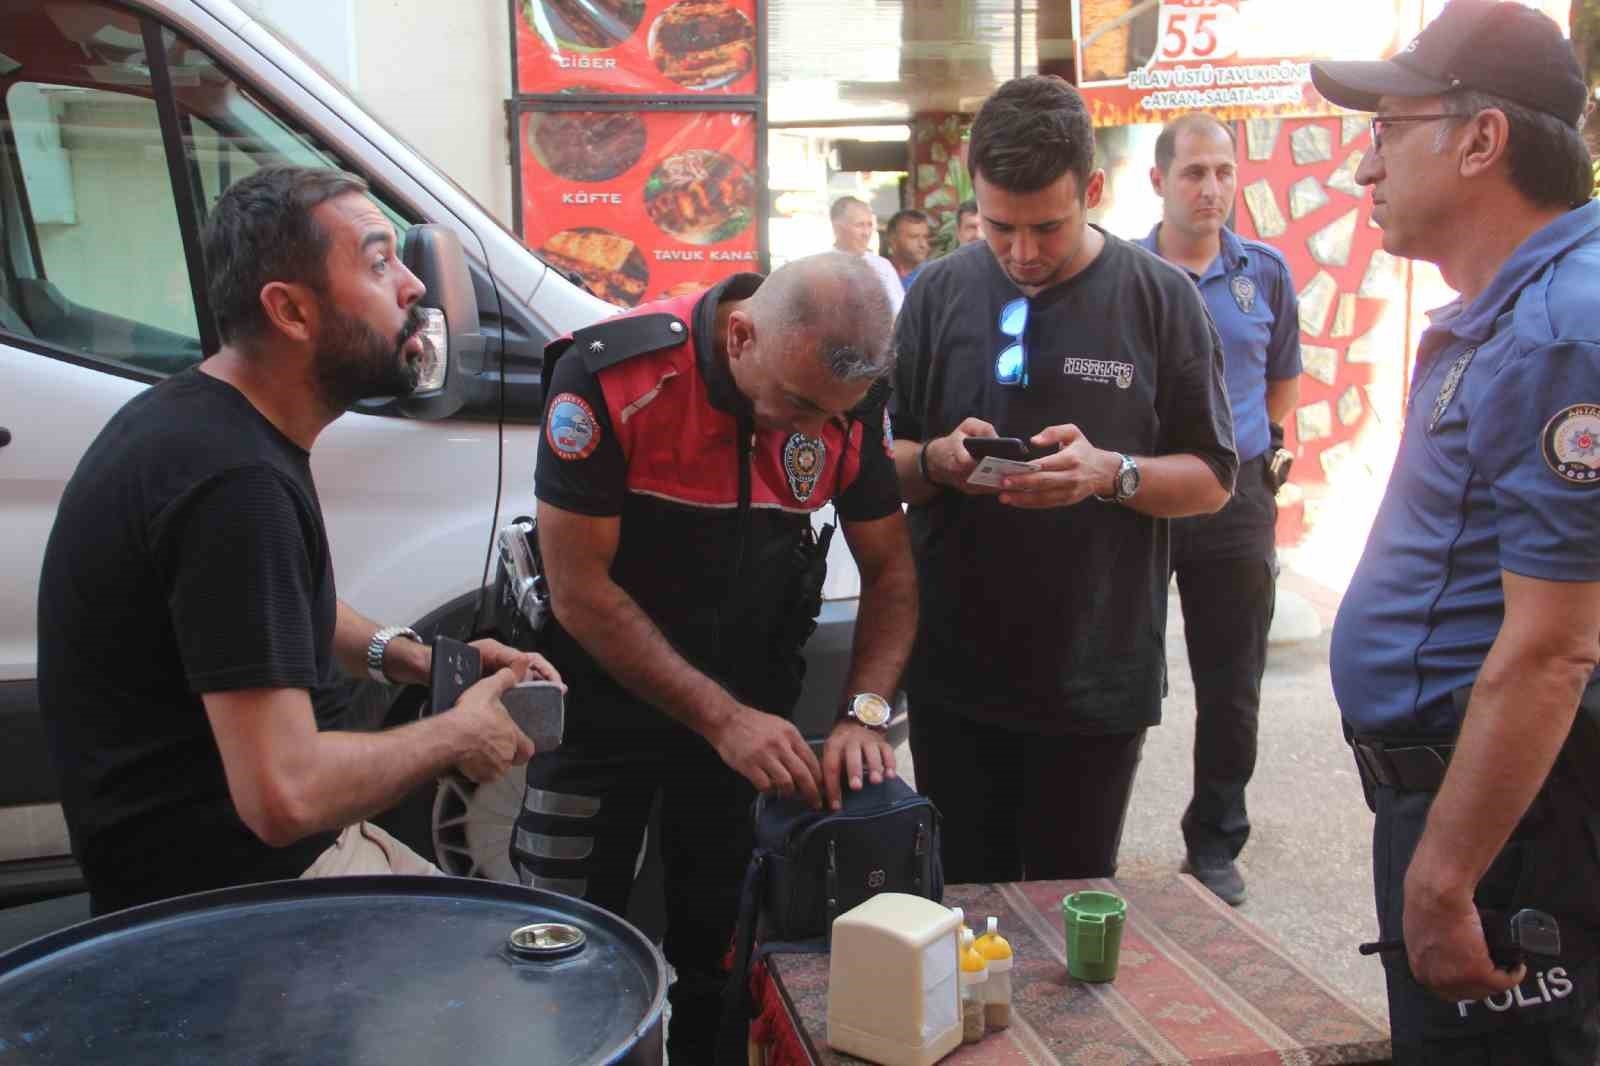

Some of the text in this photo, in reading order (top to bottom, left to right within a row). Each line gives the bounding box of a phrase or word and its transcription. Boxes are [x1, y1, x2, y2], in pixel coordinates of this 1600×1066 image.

[1162, 13, 1217, 58] 55
[559, 55, 617, 69] CİĞER
[1130, 68, 1170, 87] PİLAV
[1175, 65, 1212, 85] ÜSTÜ
[561, 190, 623, 204] KÖFTE
[653, 249, 705, 261] TAVUK
